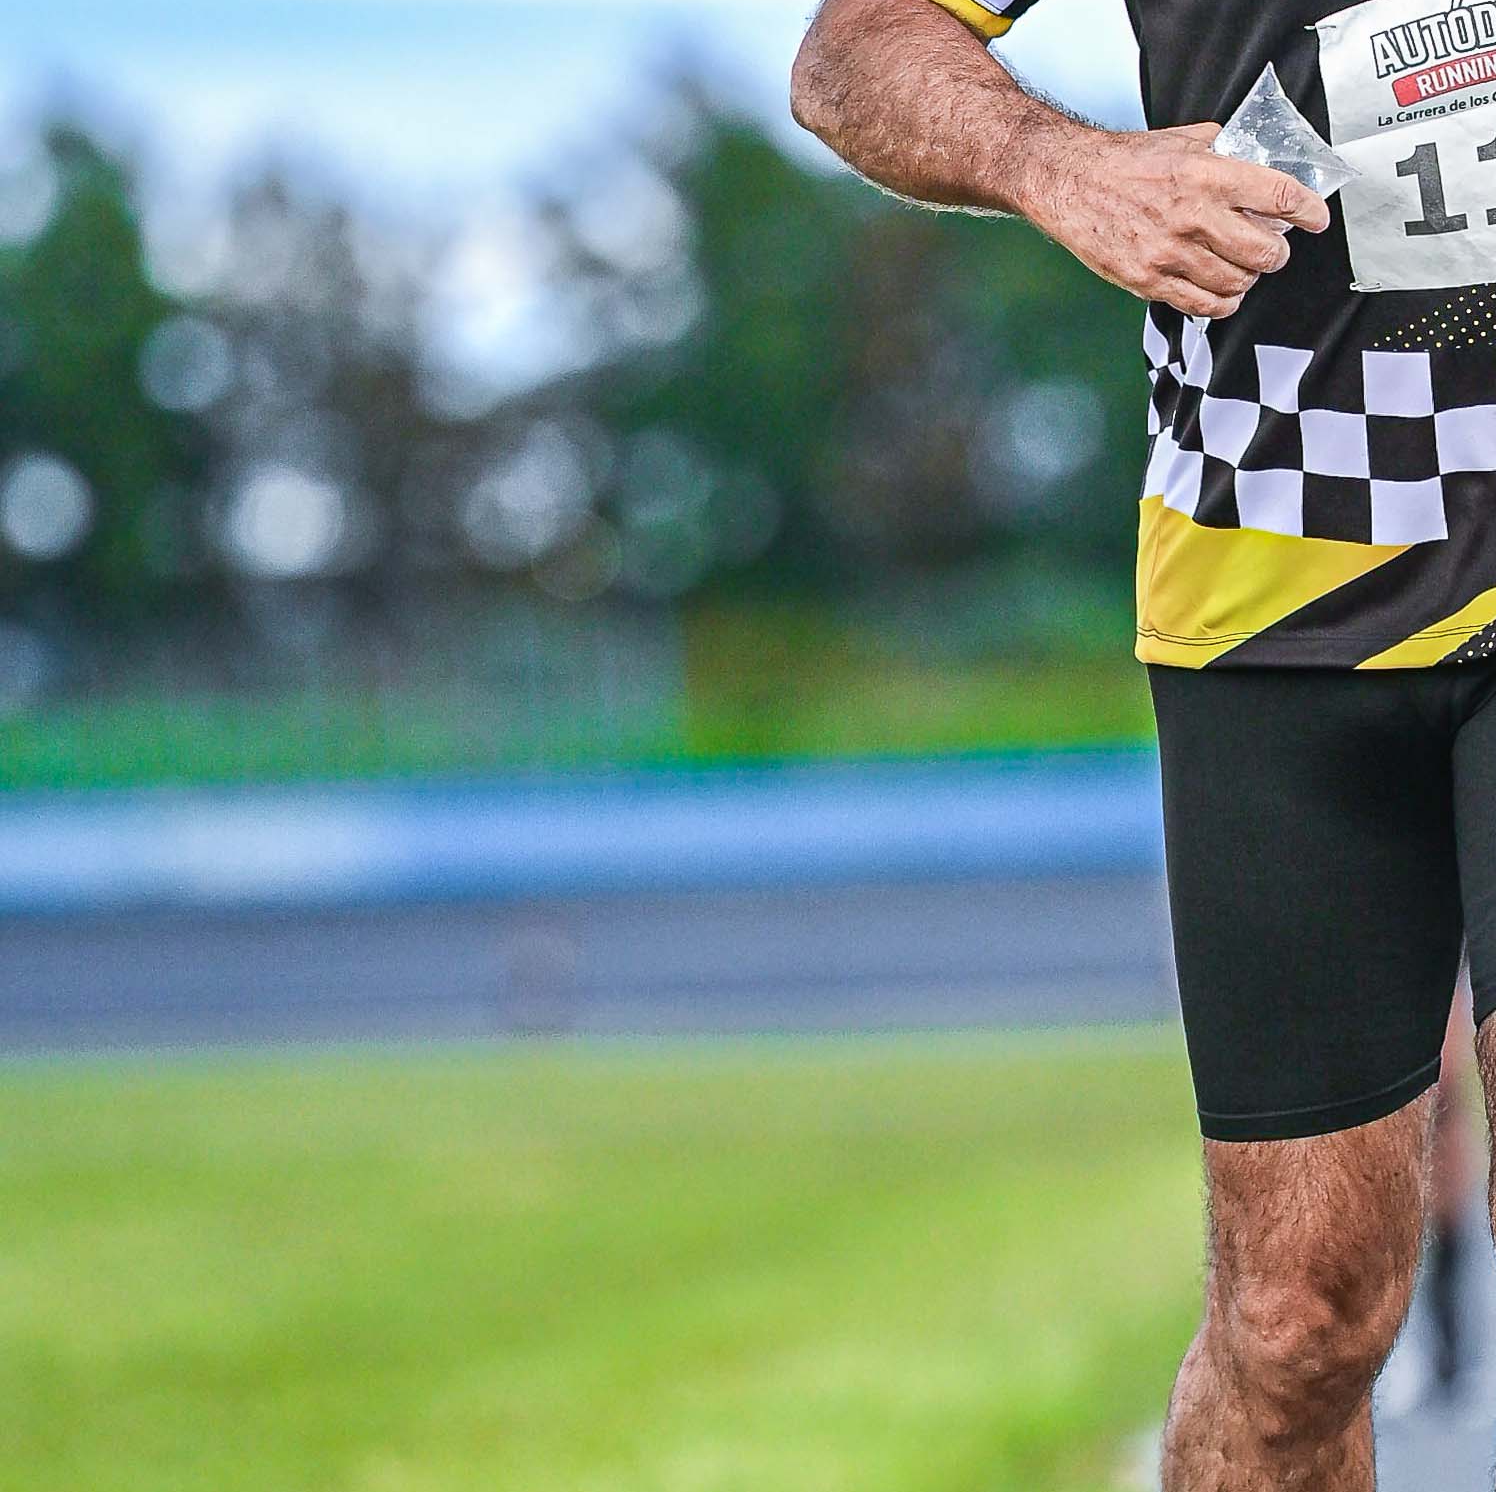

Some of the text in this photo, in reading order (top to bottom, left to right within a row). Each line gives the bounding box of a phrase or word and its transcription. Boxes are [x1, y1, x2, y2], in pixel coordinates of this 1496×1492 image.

[1378, 115, 1394, 127] La
[1396, 105, 1447, 123] Carrera
[1449, 99, 1467, 112] de
[1469, 95, 1489, 108] los
